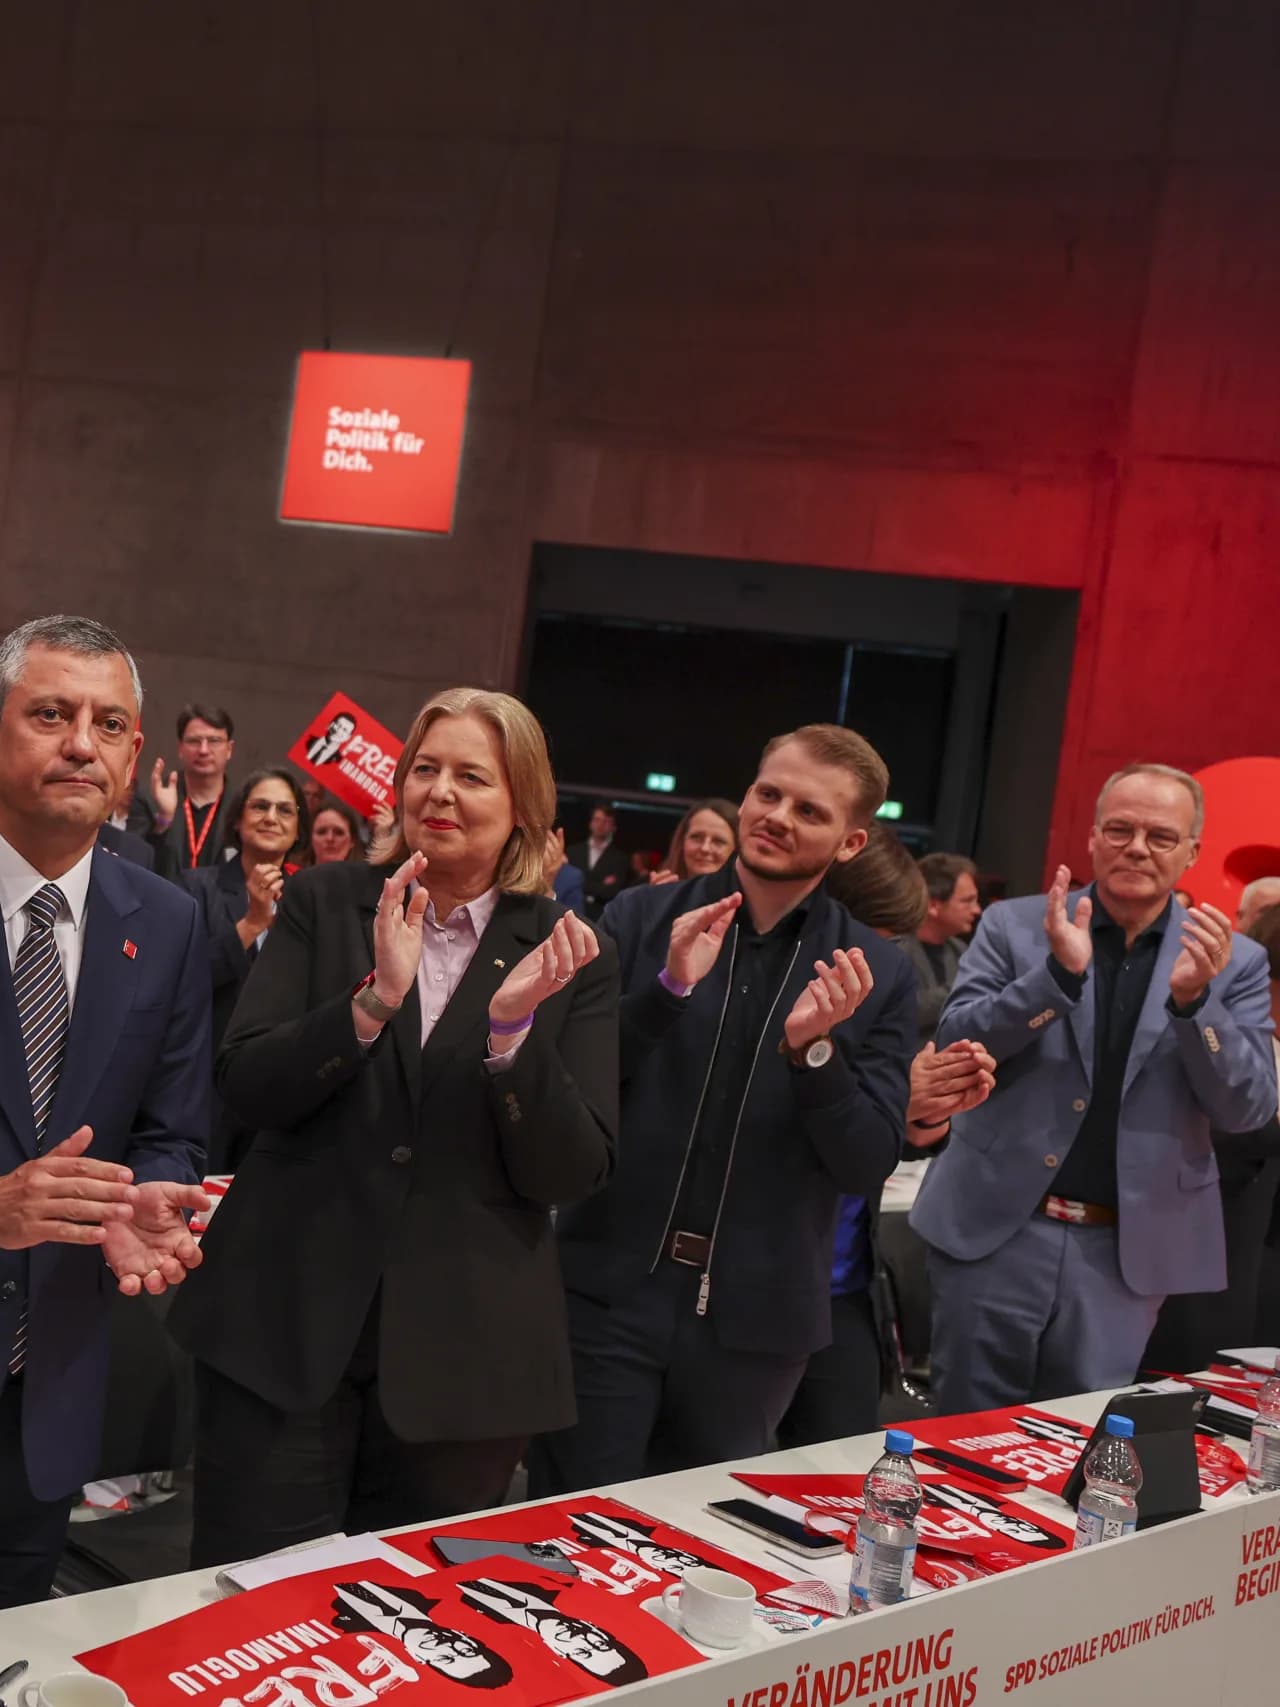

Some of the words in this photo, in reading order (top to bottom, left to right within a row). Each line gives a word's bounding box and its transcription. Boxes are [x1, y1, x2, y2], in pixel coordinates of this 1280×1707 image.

[328, 405, 400, 431] Soziale
[325, 427, 389, 452] Politik
[392, 431, 424, 454] für
[322, 449, 373, 472] Dich.
[168, 1618, 341, 1696] IMAMOGLU
[1004, 1659, 1036, 1693] SPD
[1038, 1637, 1099, 1680] SOZIALE
[1100, 1616, 1153, 1657] POLITIK
[1154, 1604, 1181, 1637] FÜR
[1182, 1595, 1215, 1627] DICH.
